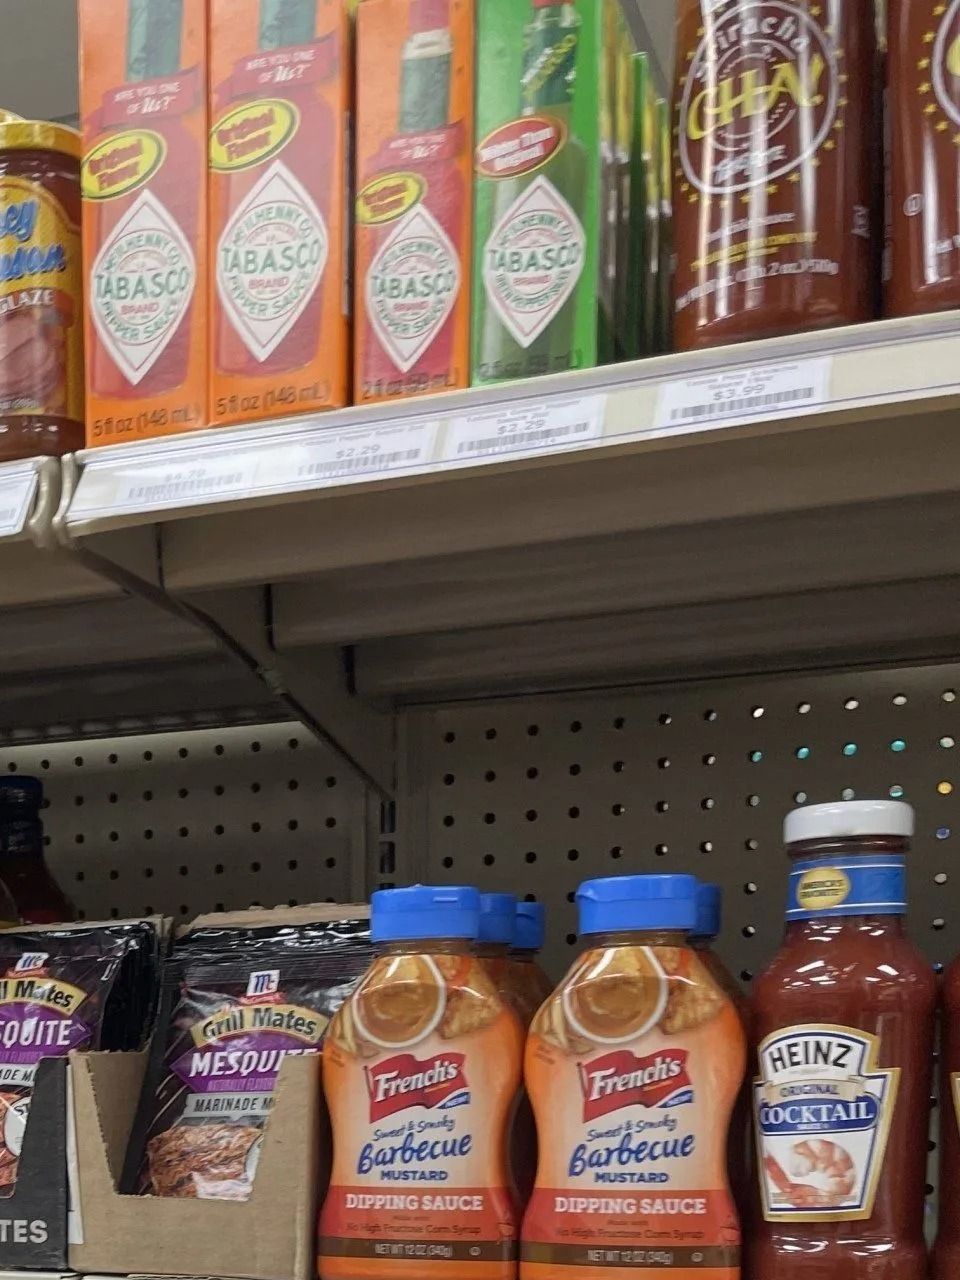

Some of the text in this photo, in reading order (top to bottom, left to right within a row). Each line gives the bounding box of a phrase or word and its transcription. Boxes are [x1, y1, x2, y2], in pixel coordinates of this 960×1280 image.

[221, 238, 322, 274] TABASCO
[491, 248, 580, 274] TABASCO
[95, 266, 190, 301] TABASCO
[248, 276, 289, 289] BRAND
[372, 270, 455, 299] TABASCO
[120, 302, 159, 316] BRAND
[713, 384, 766, 400] $3.99
[497, 419, 545, 436] $2.29
[14, 978, 75, 1007] Mates
[201, 1006, 318, 1040] Grill Mates
[190, 1046, 319, 1078] MESQUI
[768, 1039, 855, 1073] HEINZ
[375, 1059, 458, 1102] French's
[589, 1056, 682, 1100] French's
[193, 1096, 259, 1113] MARINADE
[760, 1102, 873, 1126] COCKTAIL
[373, 1125, 406, 1142] Sweet
[357, 1133, 472, 1175] Barbecue
[568, 1133, 696, 1177] Barbecue
[380, 1169, 448, 1181] MUSTARD
[594, 1170, 669, 1183] MUSTARD
[346, 1194, 483, 1212] DIPPING SAUCE
[554, 1196, 707, 1215] DIPPING SAUCE
